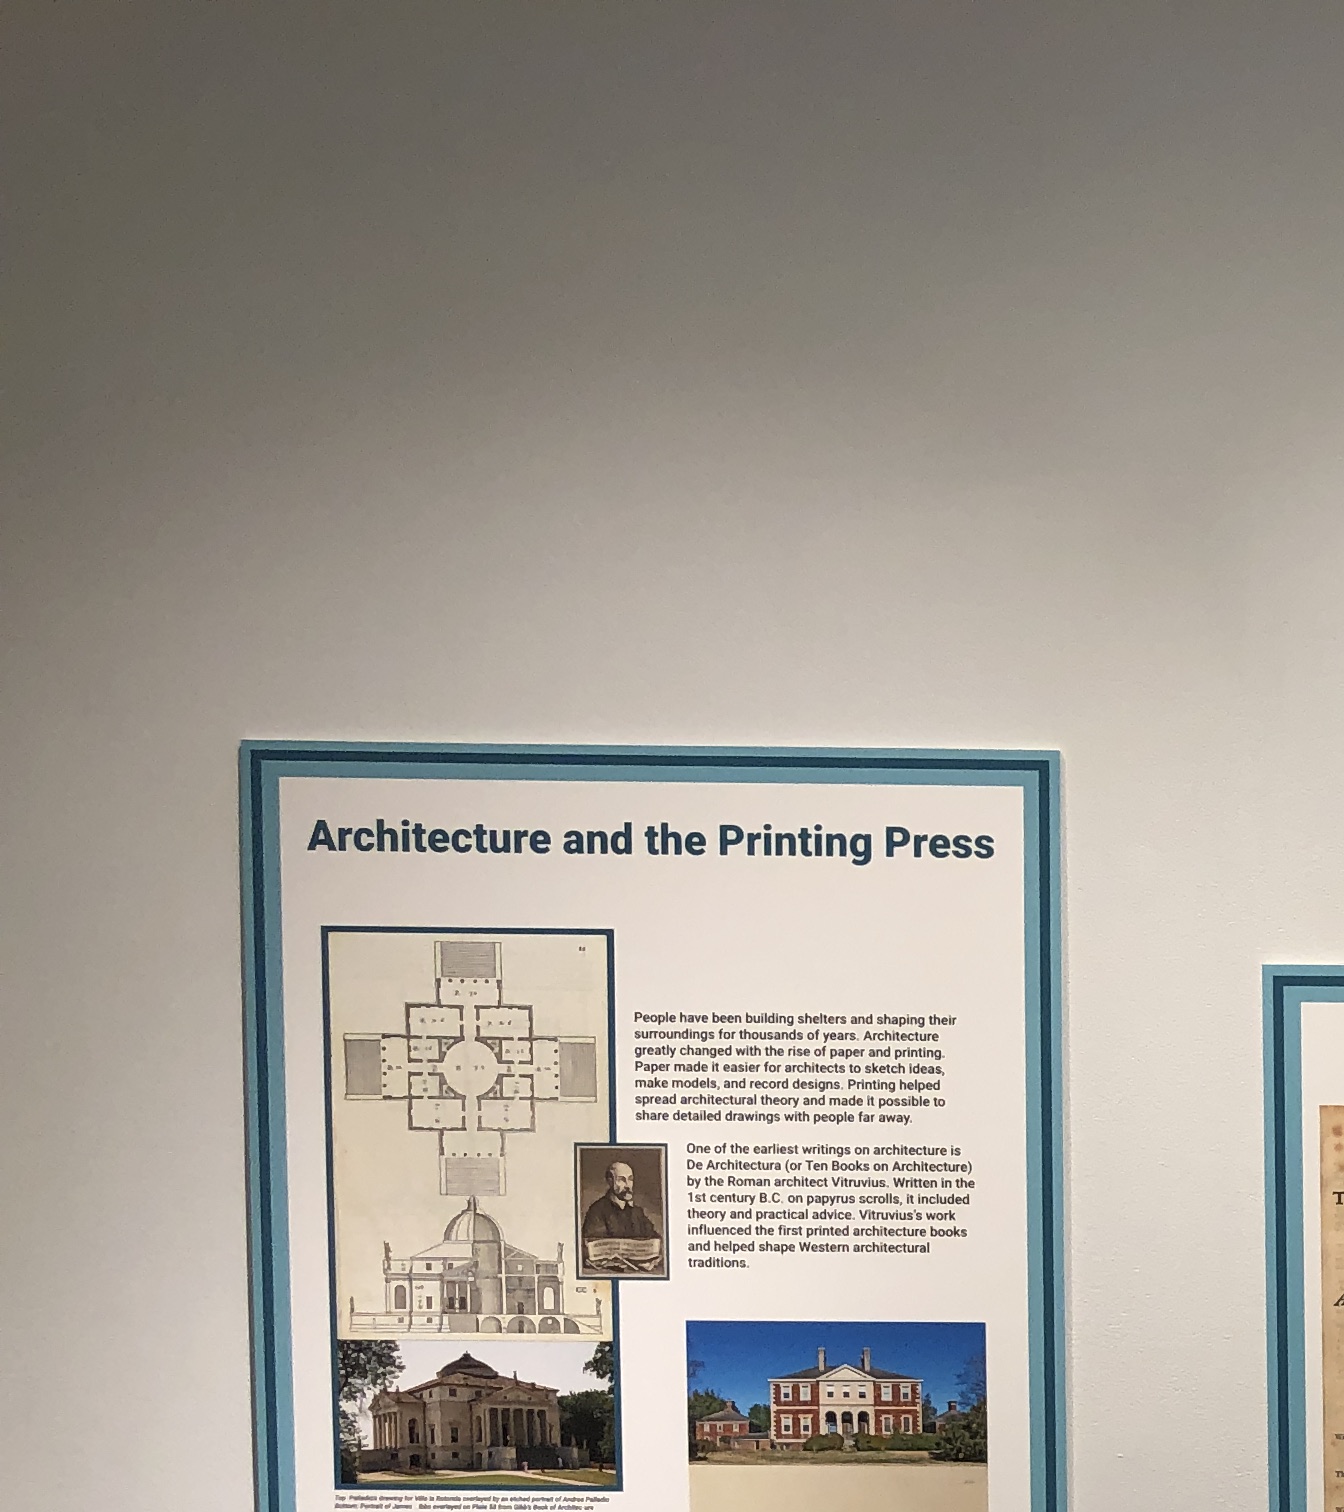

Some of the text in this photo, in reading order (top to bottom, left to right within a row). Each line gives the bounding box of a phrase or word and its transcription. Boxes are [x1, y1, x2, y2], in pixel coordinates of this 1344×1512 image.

[307, 818, 995, 866] Architecture and the Printing Press
[633, 1011, 957, 1028] People have been building shelters and shaping their
[634, 1027, 939, 1044] surroundings for thousands of years. Architecture
[634, 1076, 940, 1093] make models, and record designs. Printing helped
[686, 1142, 961, 1158] One of the earliest writings on architecture is
[686, 1174, 975, 1189] by the Roman architect Vitruvius. Written in the
